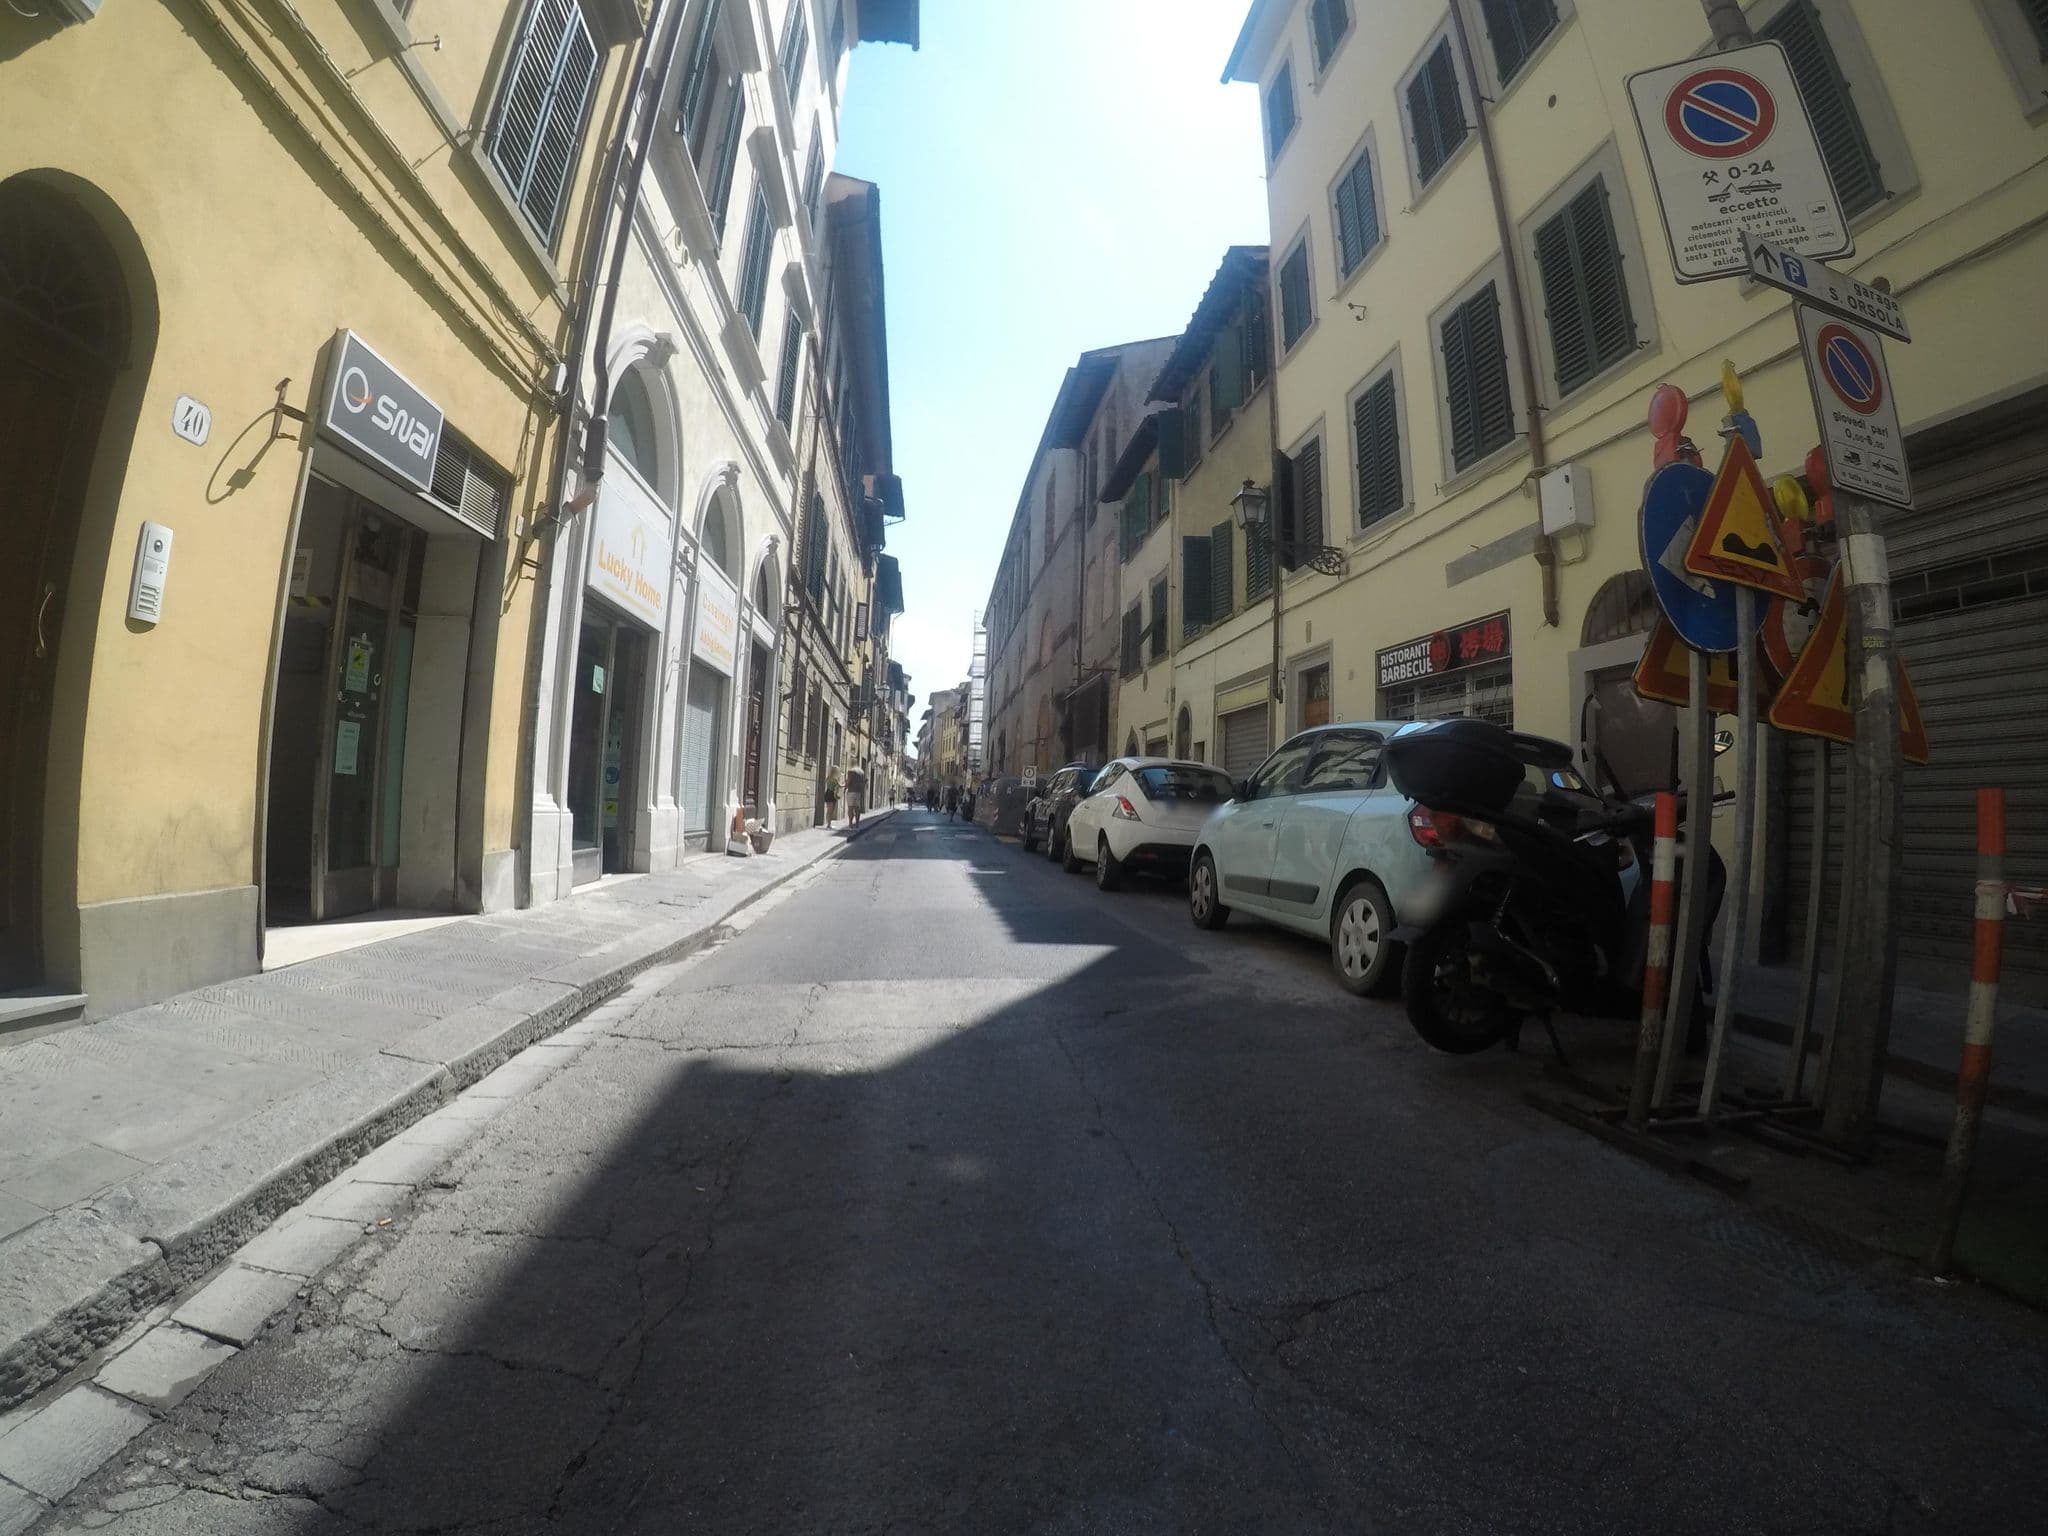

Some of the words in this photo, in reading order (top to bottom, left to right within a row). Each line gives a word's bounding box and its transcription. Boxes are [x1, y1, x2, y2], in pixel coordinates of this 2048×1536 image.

[1728, 160, 1775, 179] 0-24
[1719, 196, 1778, 215] eccetto
[1691, 216, 1733, 231] motocarri
[1741, 207, 1789, 223] quadricicli
[1687, 227, 1733, 242] ciclomotori
[1788, 225, 1806, 235] alla
[1685, 252, 1708, 263] sosta
[1713, 256, 1740, 267] valido
[1853, 283, 1898, 312] garage
[1848, 295, 1904, 330] ORSOLA
[181, 404, 204, 438] 40
[598, 539, 634, 591] Lucky
[1381, 657, 1433, 684] BARBECUE
